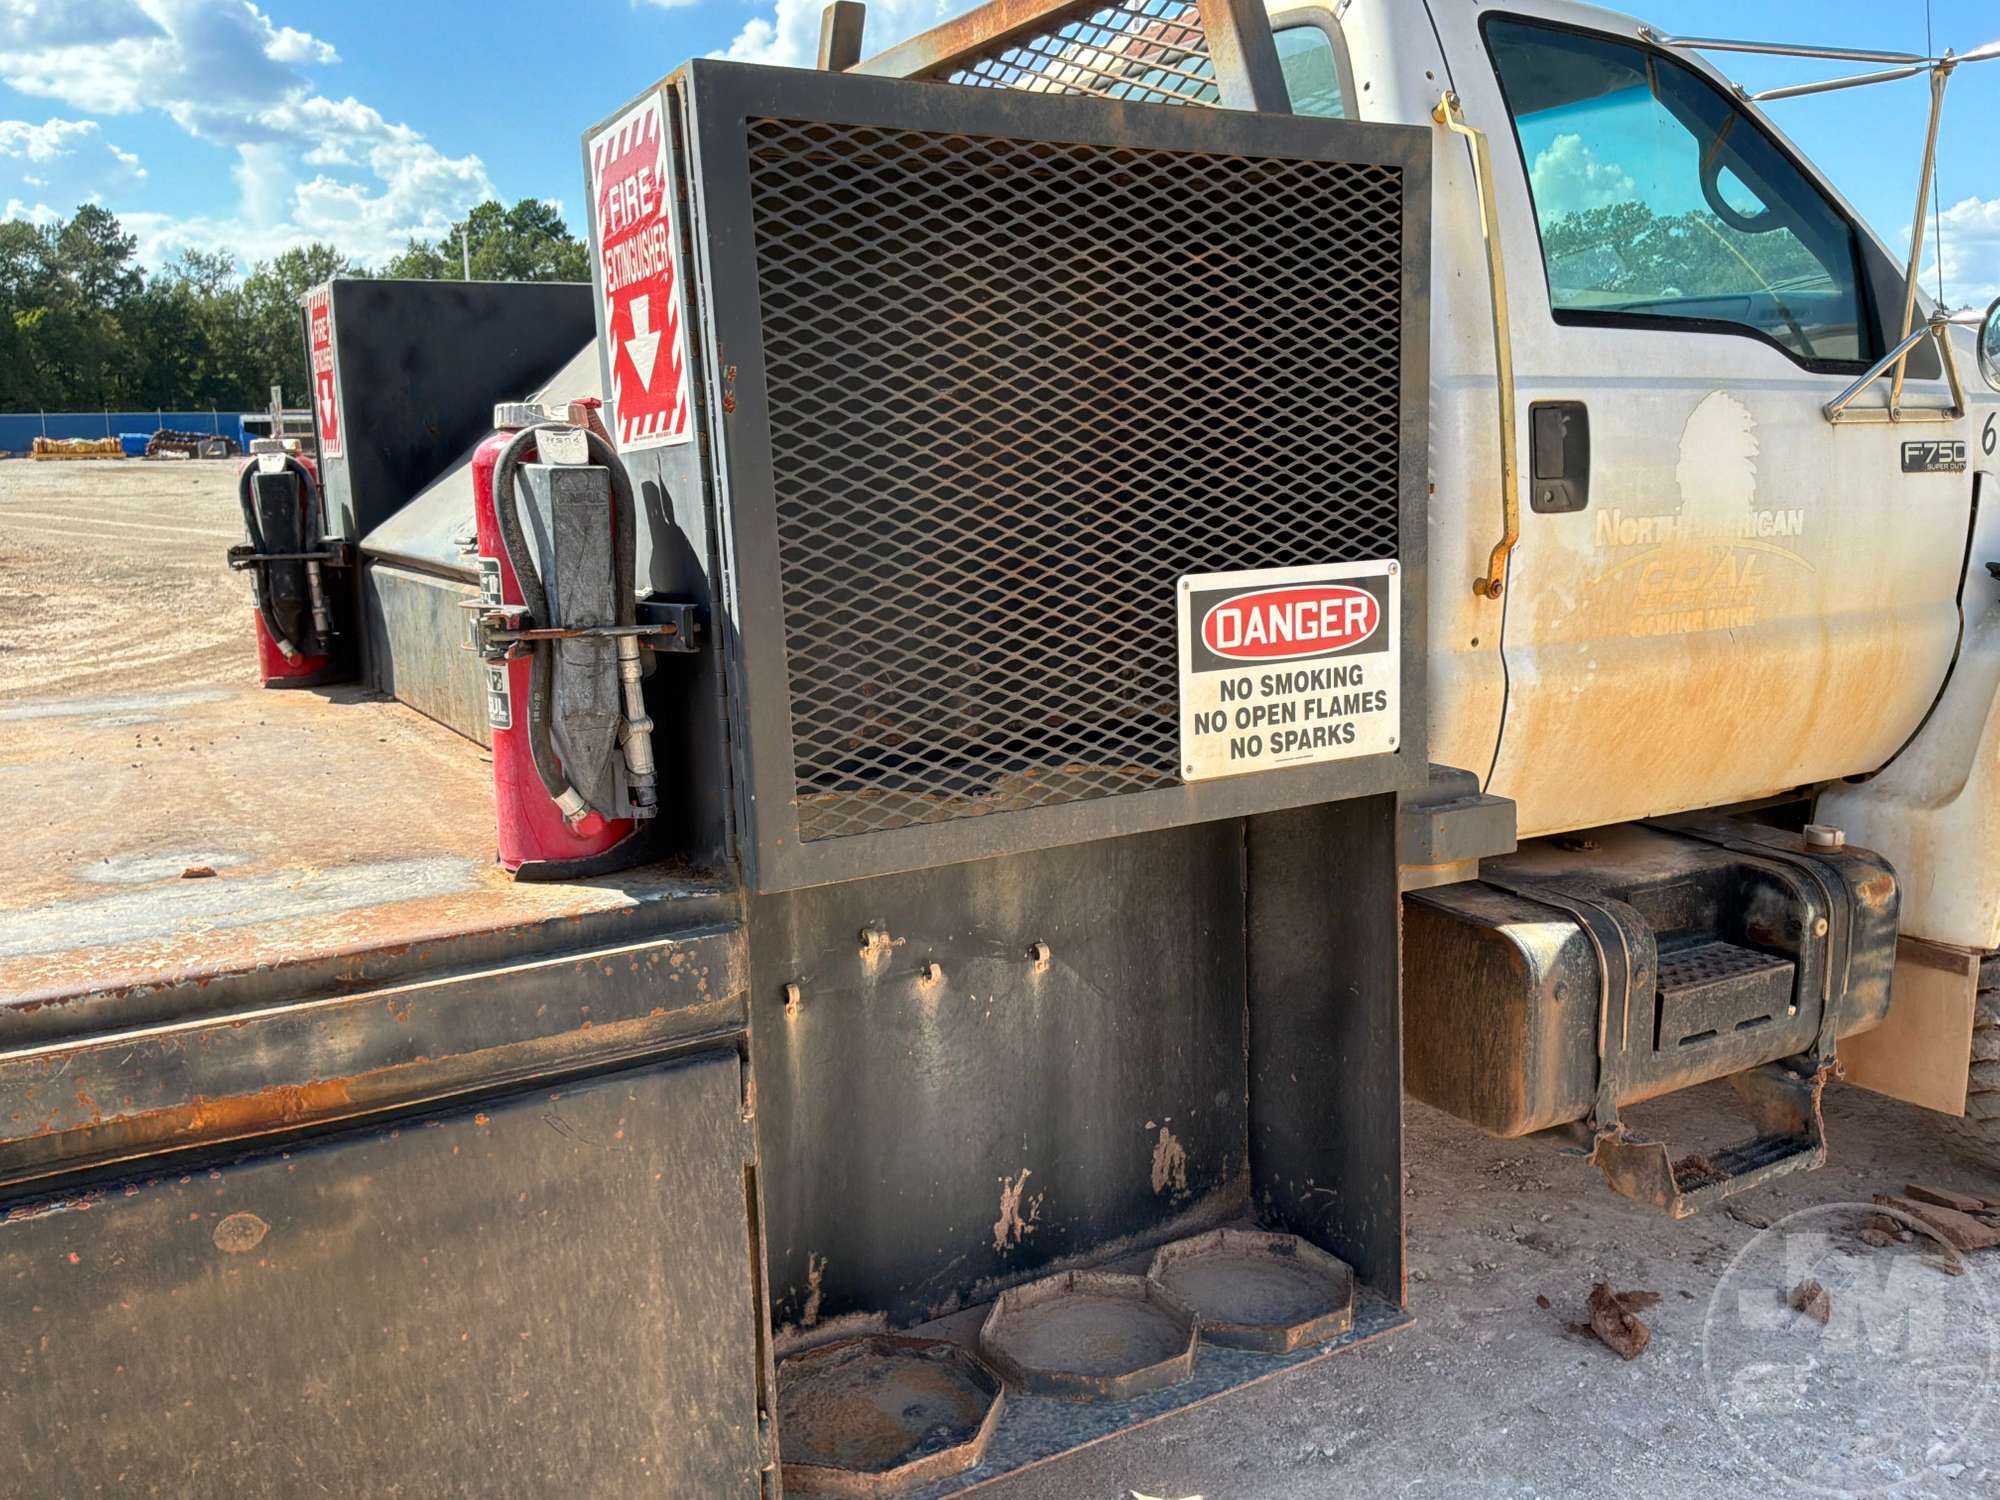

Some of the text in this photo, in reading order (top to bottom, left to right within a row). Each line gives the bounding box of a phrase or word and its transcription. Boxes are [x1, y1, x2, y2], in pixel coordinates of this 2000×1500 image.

[607, 167, 655, 232] FIRE
[605, 224, 670, 293] EXTINGUISHER
[1904, 442, 1967, 463] F-750
[1981, 411, 1997, 456] 6
[1216, 596, 1368, 649] DANGER
[1220, 664, 1364, 702] NO SMOKING
[1194, 689, 1387, 735] NO OPEN FLAMES
[1230, 722, 1356, 760] NO SPARKS
